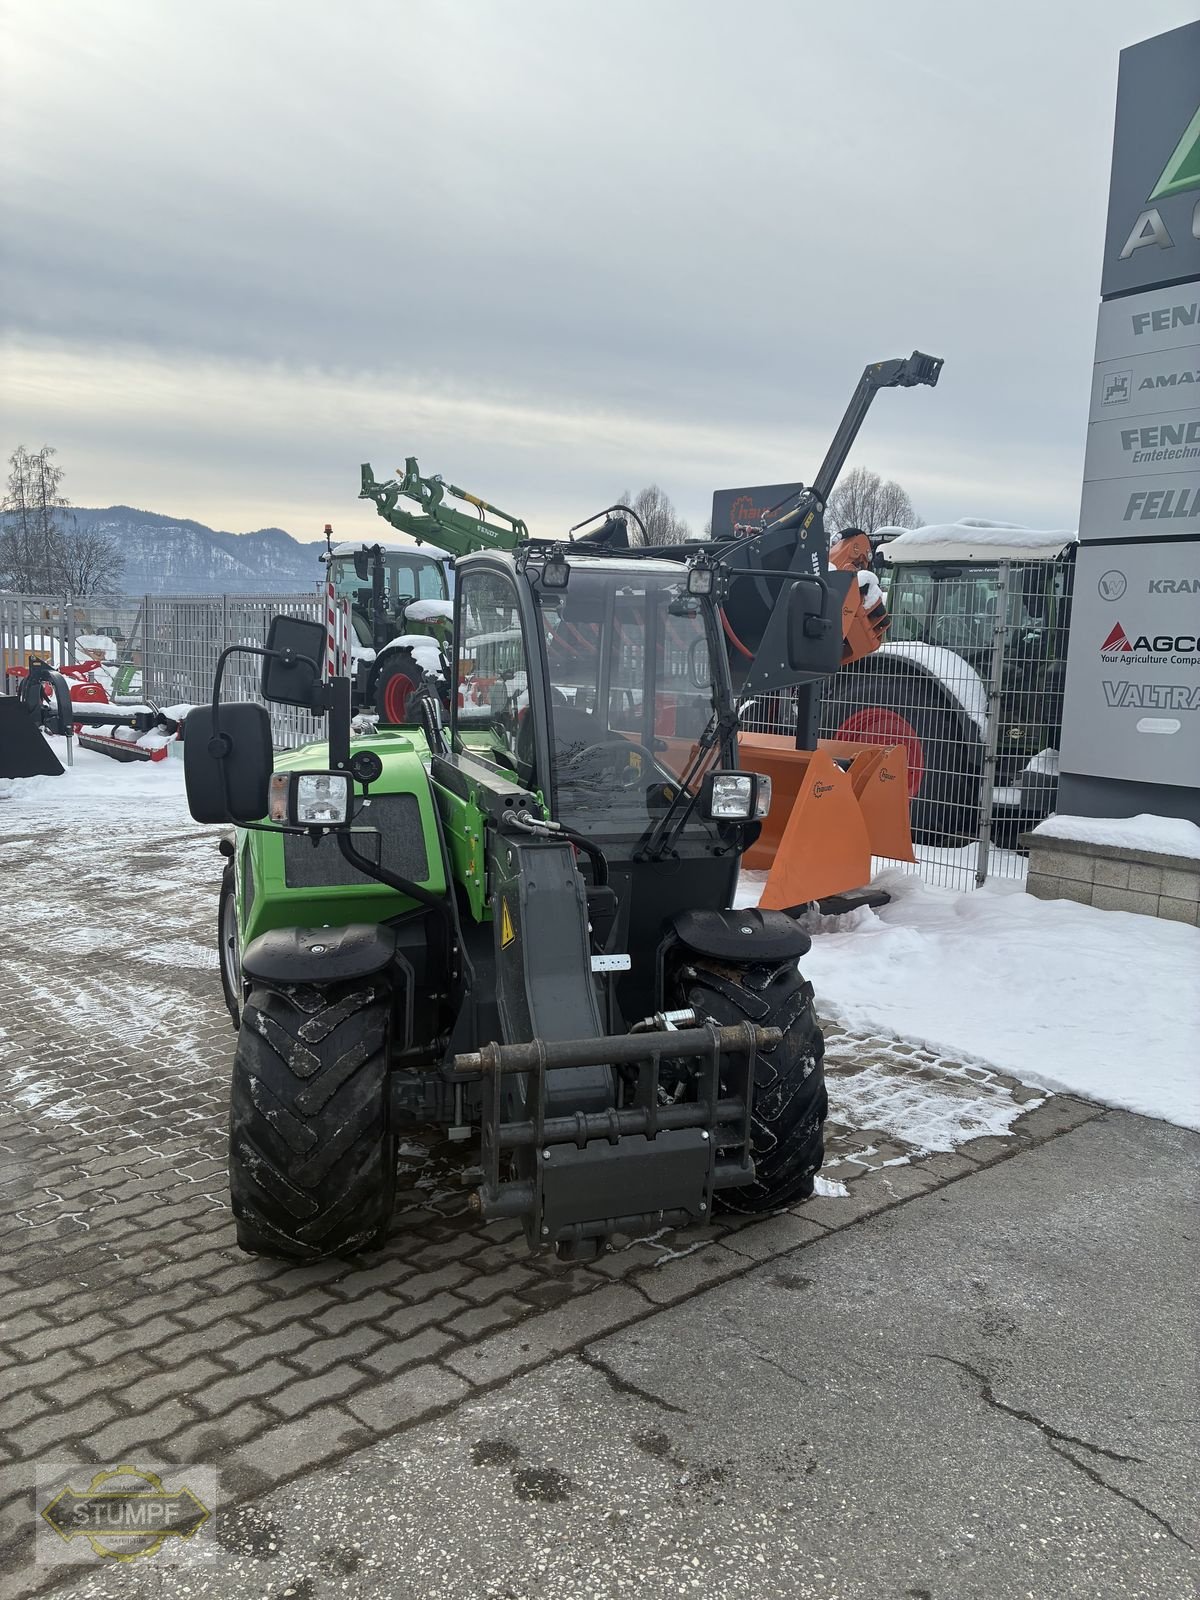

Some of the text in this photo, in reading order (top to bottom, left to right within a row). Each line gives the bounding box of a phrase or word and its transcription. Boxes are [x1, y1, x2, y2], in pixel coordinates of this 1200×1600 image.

[1118, 198, 1200, 261] A
[1132, 302, 1200, 336] FEN
[1138, 370, 1200, 391] AMA
[477, 525, 499, 538] FENDT
[1133, 635, 1200, 652] AGC
[1101, 654, 1118, 664] Your
[1120, 655, 1168, 666] Agriculture
